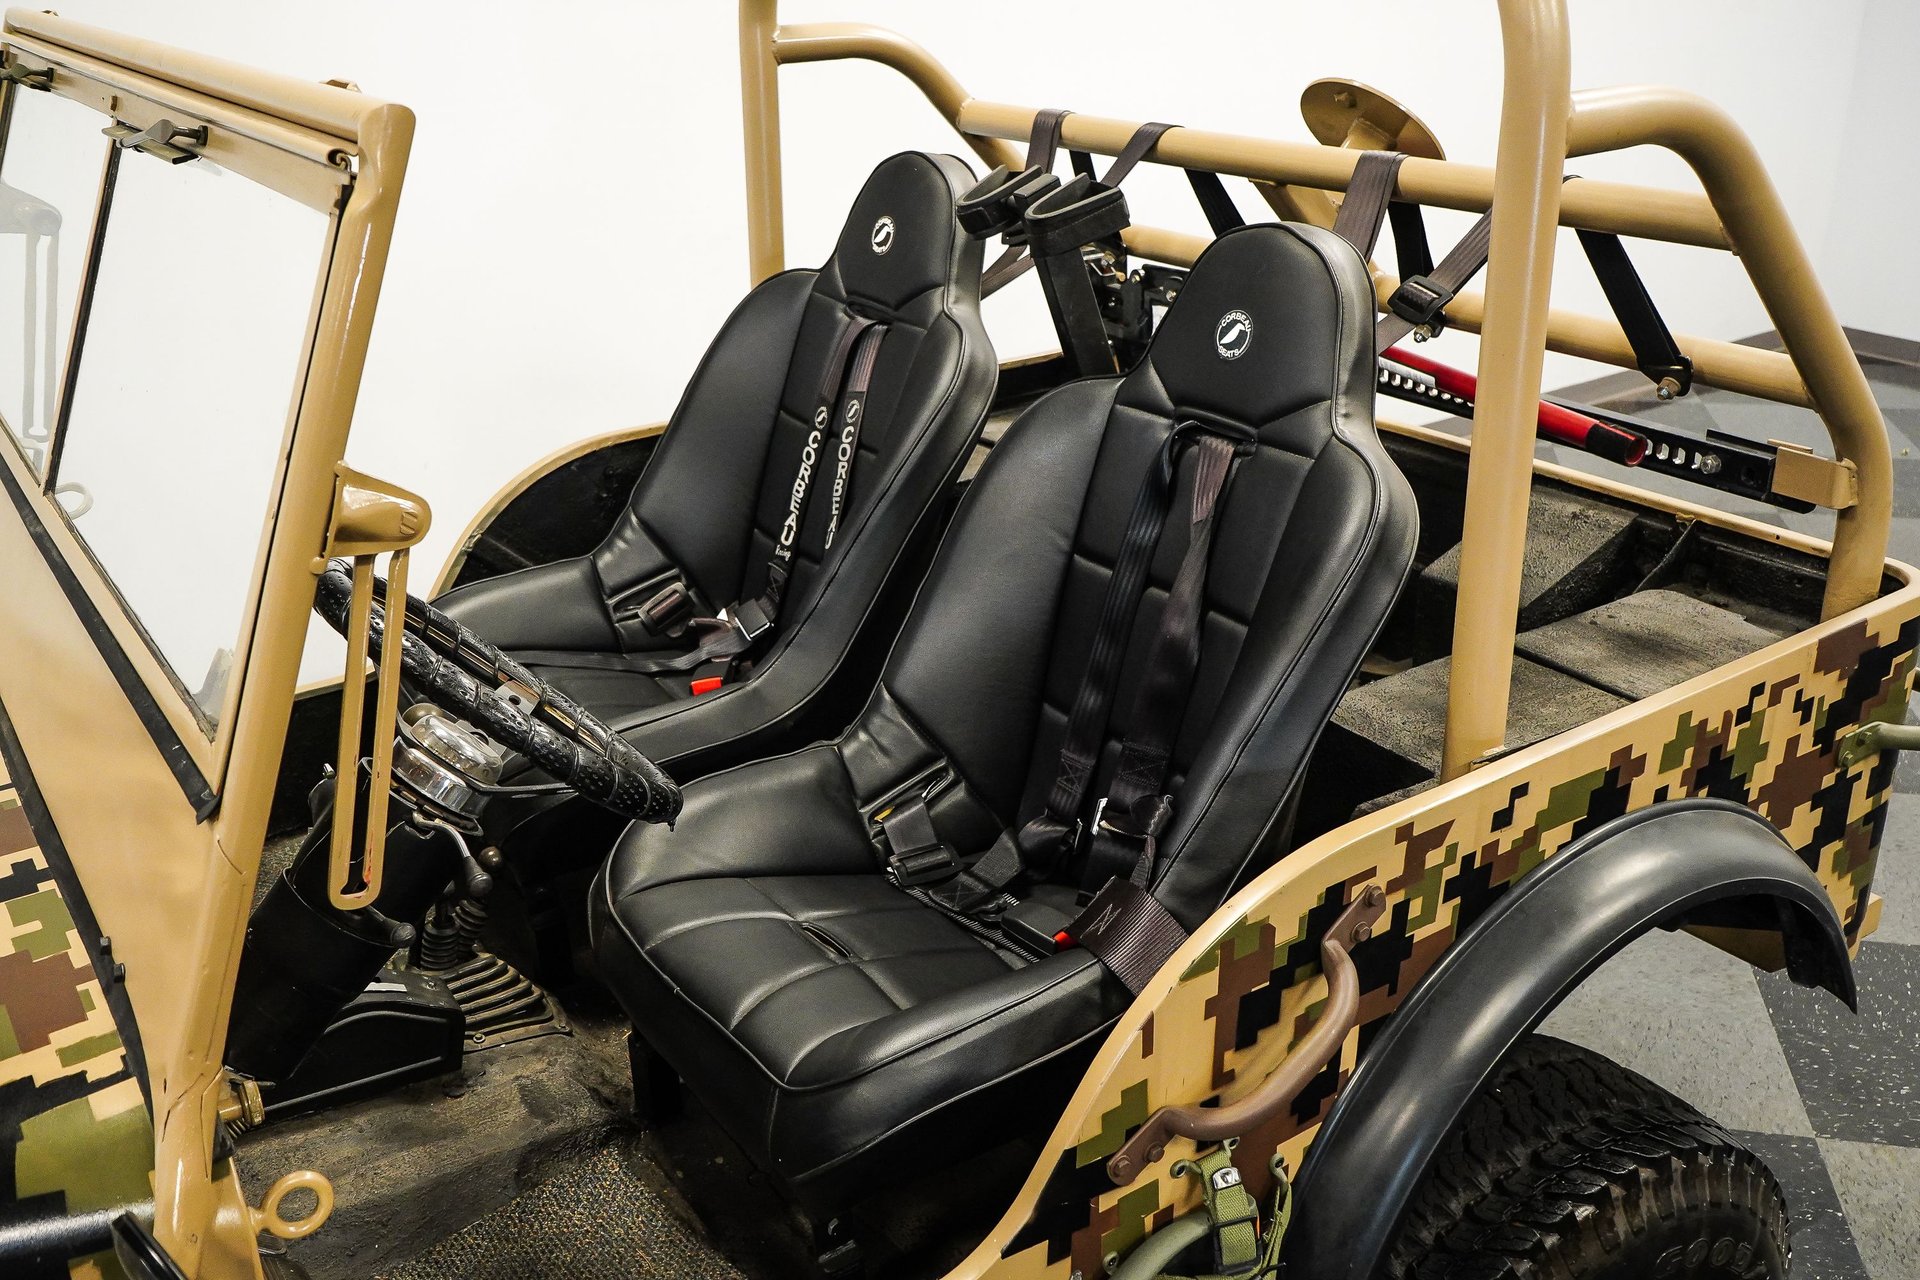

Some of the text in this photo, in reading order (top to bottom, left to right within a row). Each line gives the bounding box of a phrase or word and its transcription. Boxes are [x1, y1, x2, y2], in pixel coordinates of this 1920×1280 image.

[1218, 345, 1239, 357] SEATS
[1221, 312, 1251, 332] CORBEAU
[780, 430, 821, 546] CORBEAU
[824, 425, 855, 550] CORBEAU
